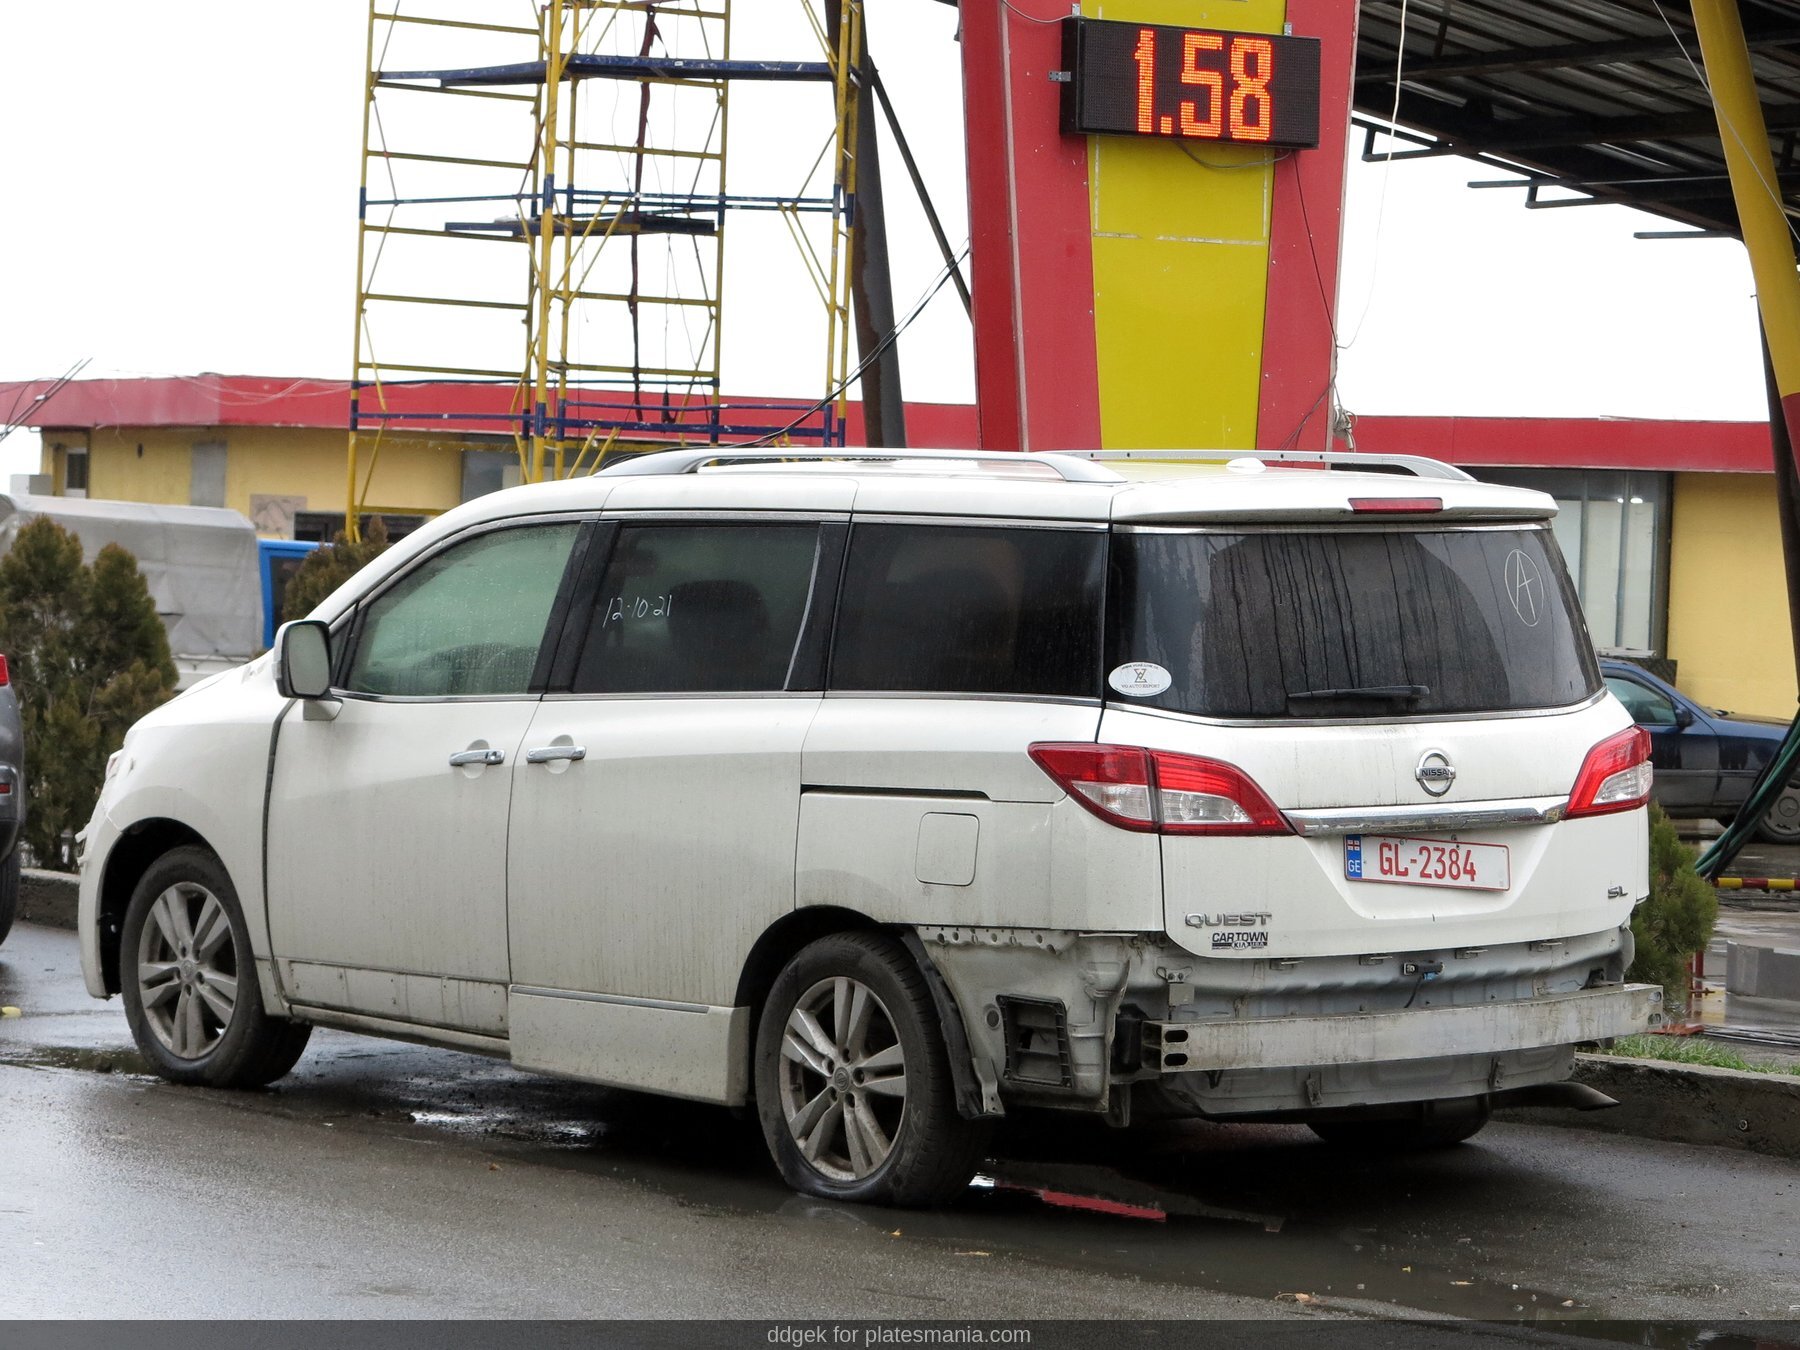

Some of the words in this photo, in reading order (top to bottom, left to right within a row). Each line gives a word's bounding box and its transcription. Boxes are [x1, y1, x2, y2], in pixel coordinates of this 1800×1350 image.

[1134, 29, 1232, 141] 1.58
[1421, 768, 1453, 777] NISSAN
[1348, 859, 1361, 873] GE
[1379, 842, 1477, 882] GL-2384
[1608, 885, 1628, 899] SL
[1185, 912, 1272, 928] QUEST
[1233, 941, 1247, 949] KIA
